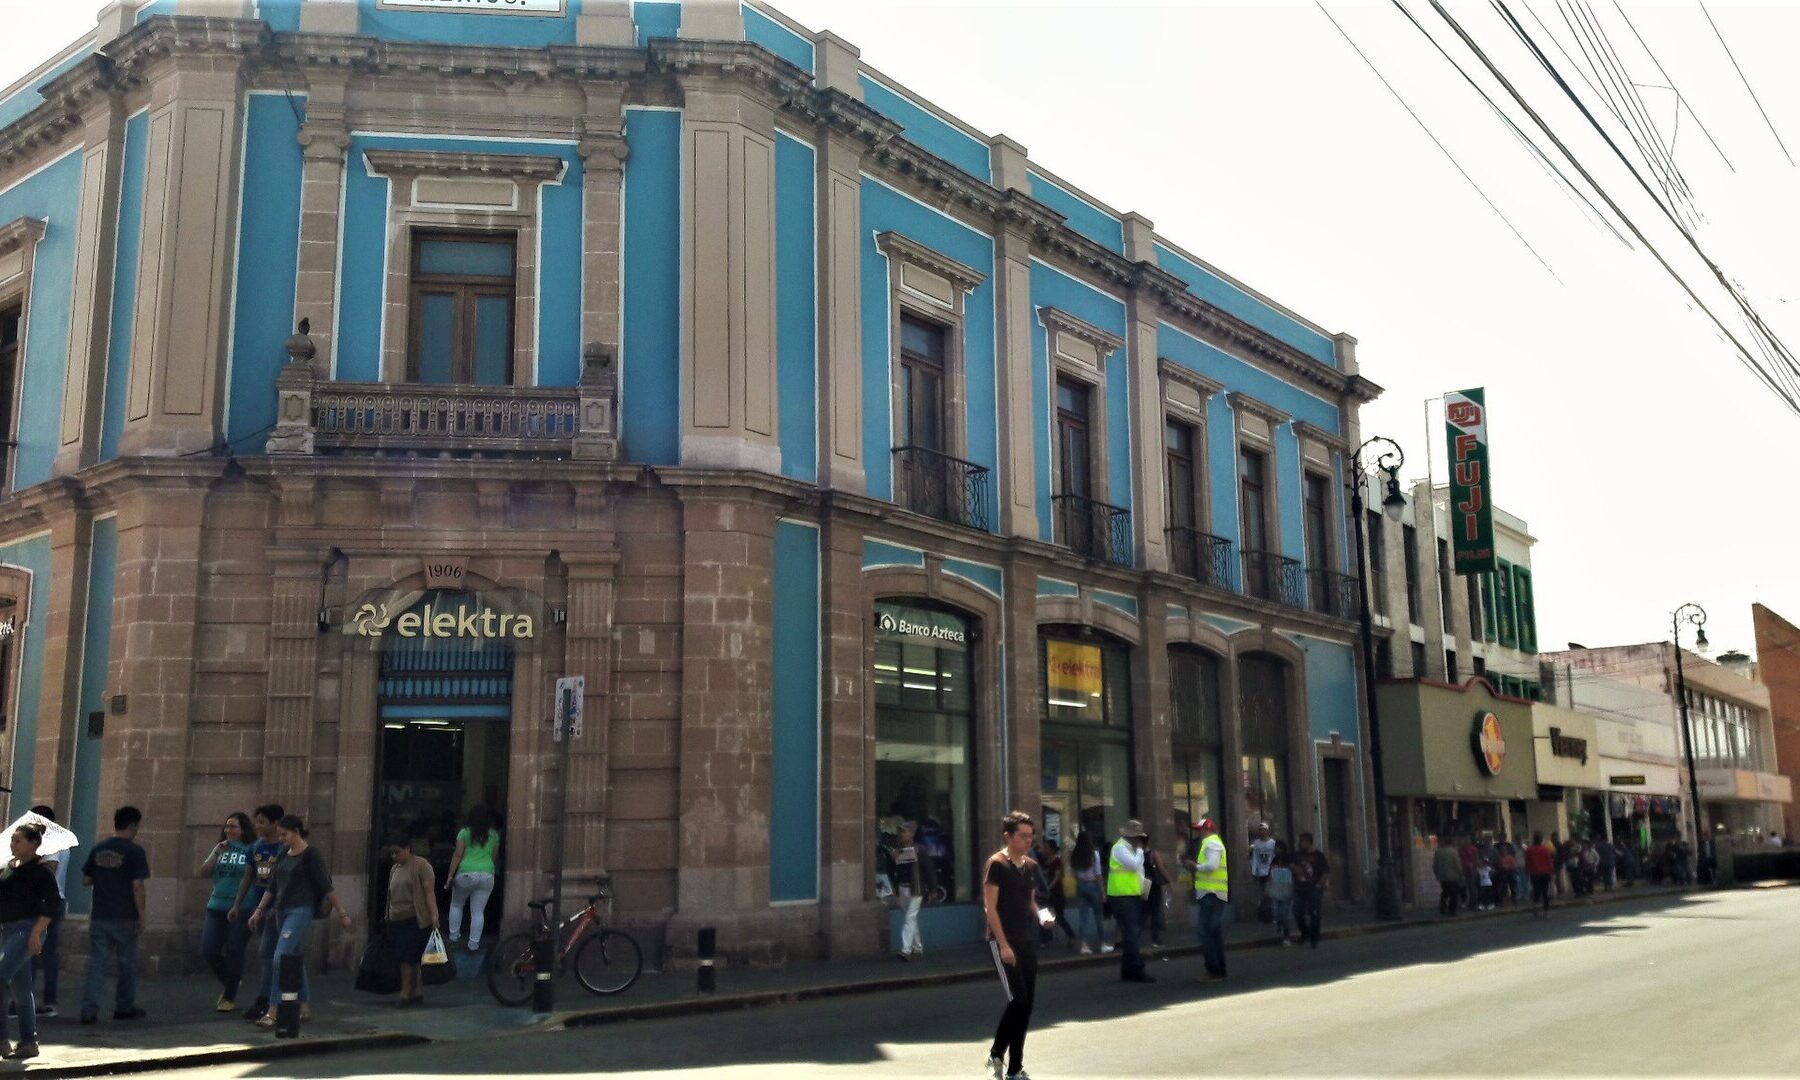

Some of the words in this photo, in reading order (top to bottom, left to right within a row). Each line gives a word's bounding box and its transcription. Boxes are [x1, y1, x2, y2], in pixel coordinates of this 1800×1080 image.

[1455, 434, 1482, 540] FUJI
[428, 563, 463, 578] 1906
[397, 604, 534, 638] elektra
[898, 619, 930, 637] Banco
[931, 625, 965, 642] Azteca
